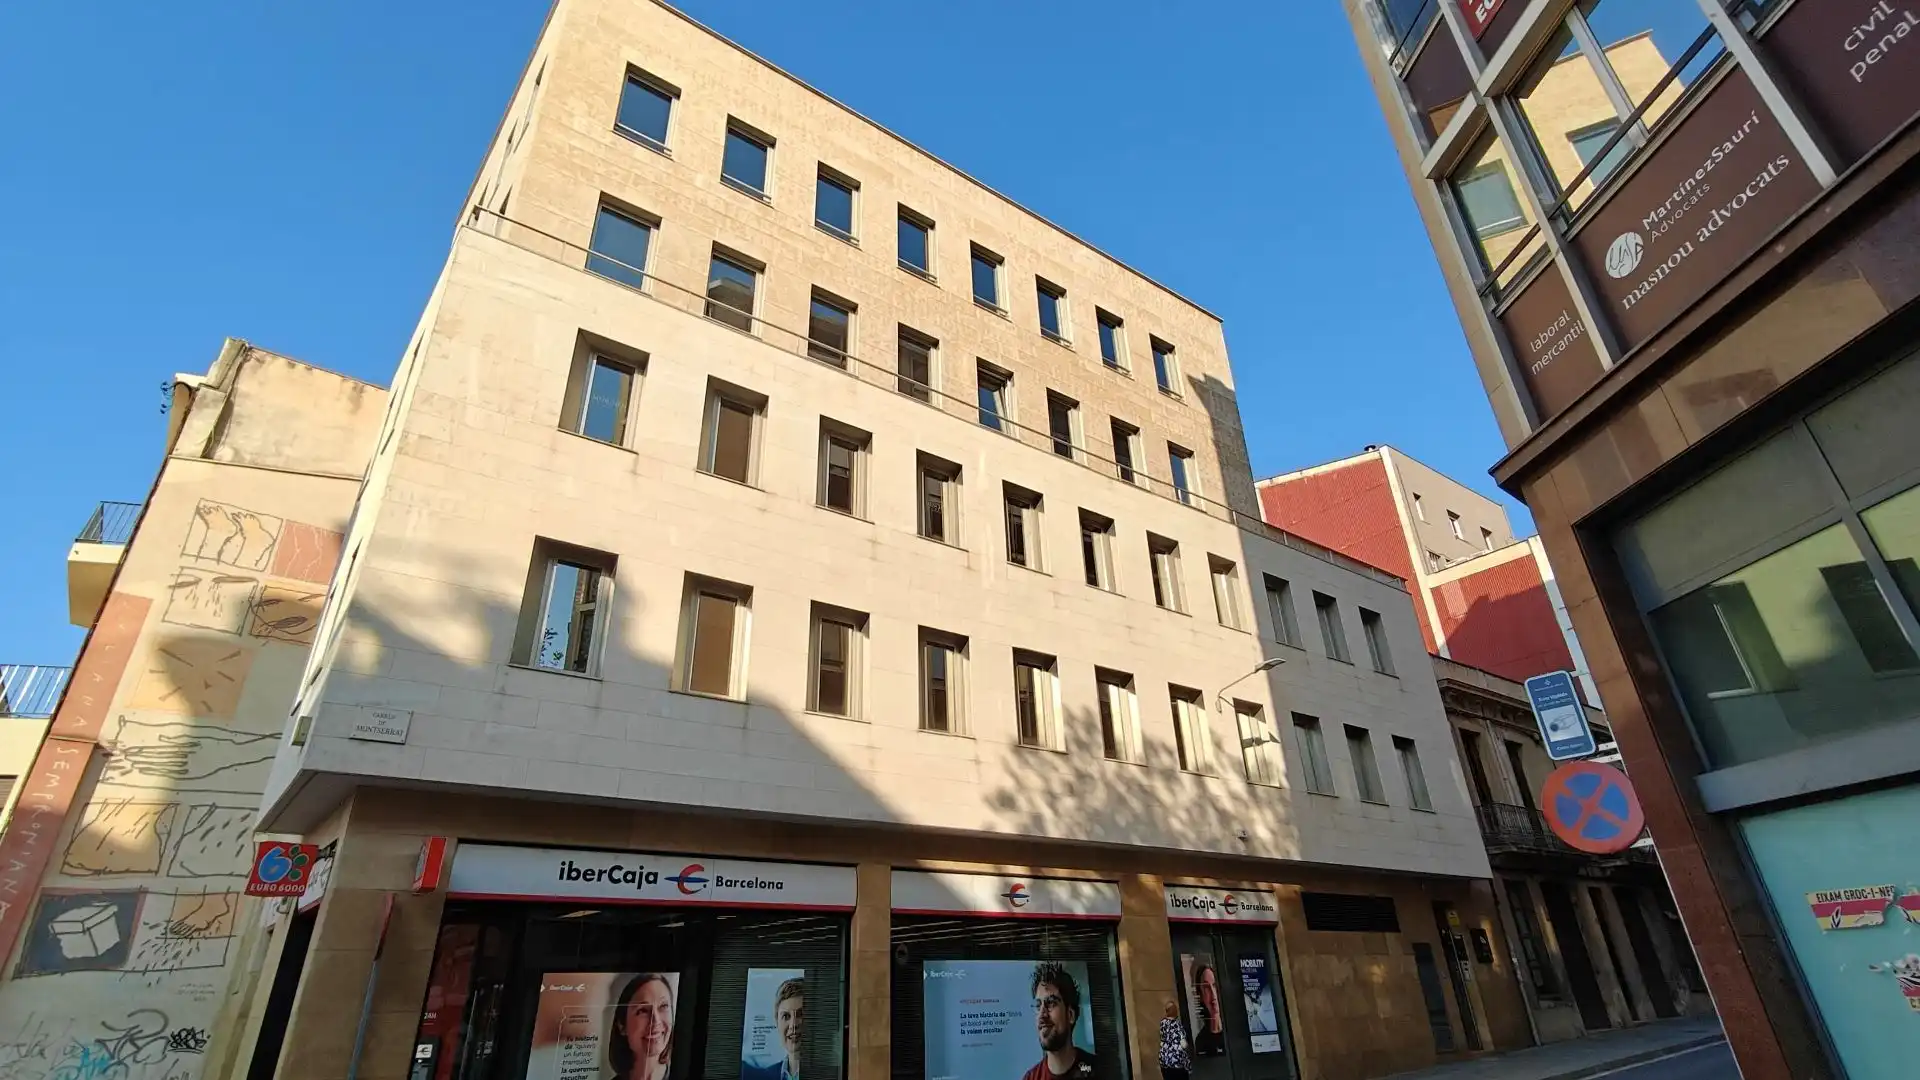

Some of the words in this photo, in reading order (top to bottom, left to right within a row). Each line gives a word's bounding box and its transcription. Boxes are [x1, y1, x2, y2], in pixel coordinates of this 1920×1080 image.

[1844, 0, 1896, 51] civil
[1849, 10, 1920, 83] penal
[1642, 112, 1760, 231] MartínezSaurí
[1621, 240, 1695, 310] masnou
[1696, 153, 1790, 242] advocats
[1651, 182, 1711, 243] Advocats
[1530, 309, 1571, 353] laboral
[1532, 319, 1586, 375] mercantil
[250, 883, 276, 892] EURO
[278, 884, 305, 893] 6000
[558, 860, 659, 890] iberCaja
[715, 875, 784, 890] Barcelona
[1815, 888, 1842, 903] EIXAM
[1170, 893, 1216, 912] iberCaja
[1240, 901, 1274, 912] Barcelona
[1239, 959, 1265, 968] MOBILITY
